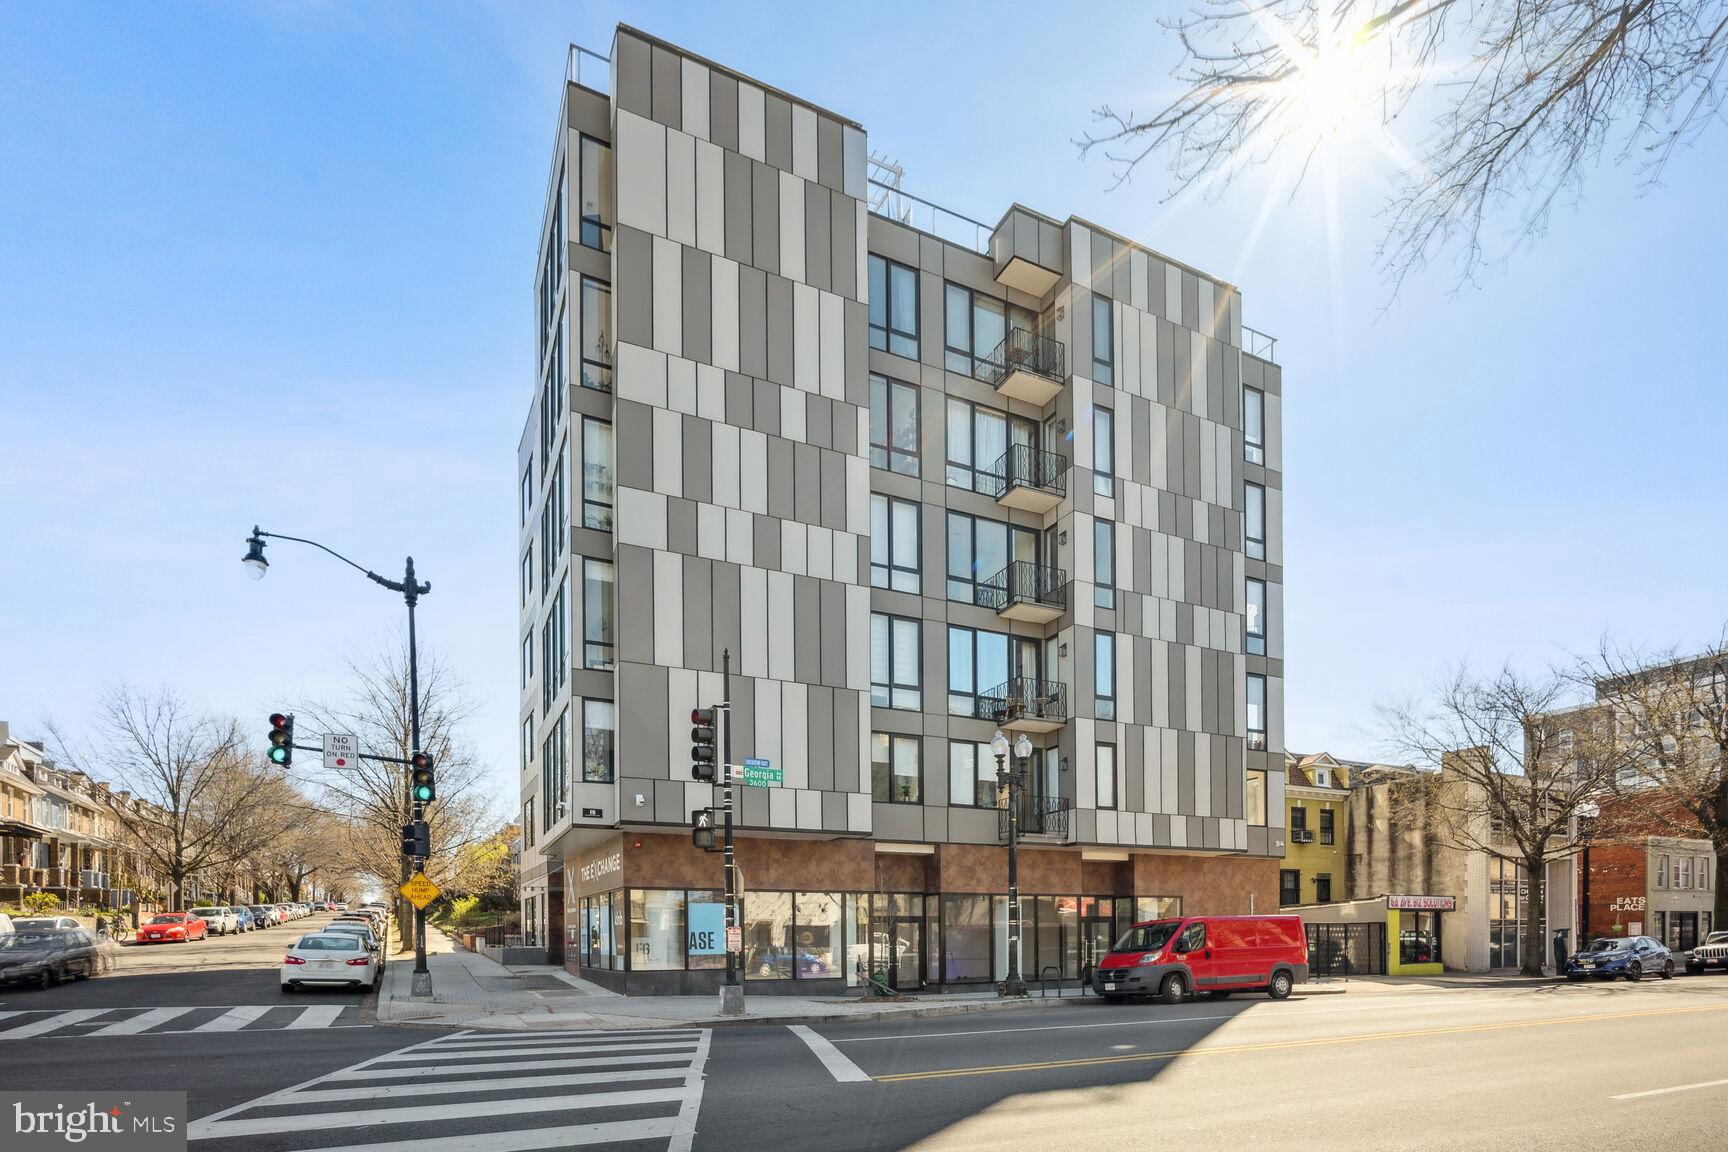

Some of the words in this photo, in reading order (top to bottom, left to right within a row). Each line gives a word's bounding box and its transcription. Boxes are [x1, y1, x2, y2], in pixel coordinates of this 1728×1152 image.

[744, 768, 774, 781] Georgia
[581, 865, 590, 882] THE
[591, 853, 620, 882] EXCHANGE
[1616, 896, 1646, 904] EATS
[1610, 903, 1645, 911] PLACE
[689, 931, 715, 950] ASE
